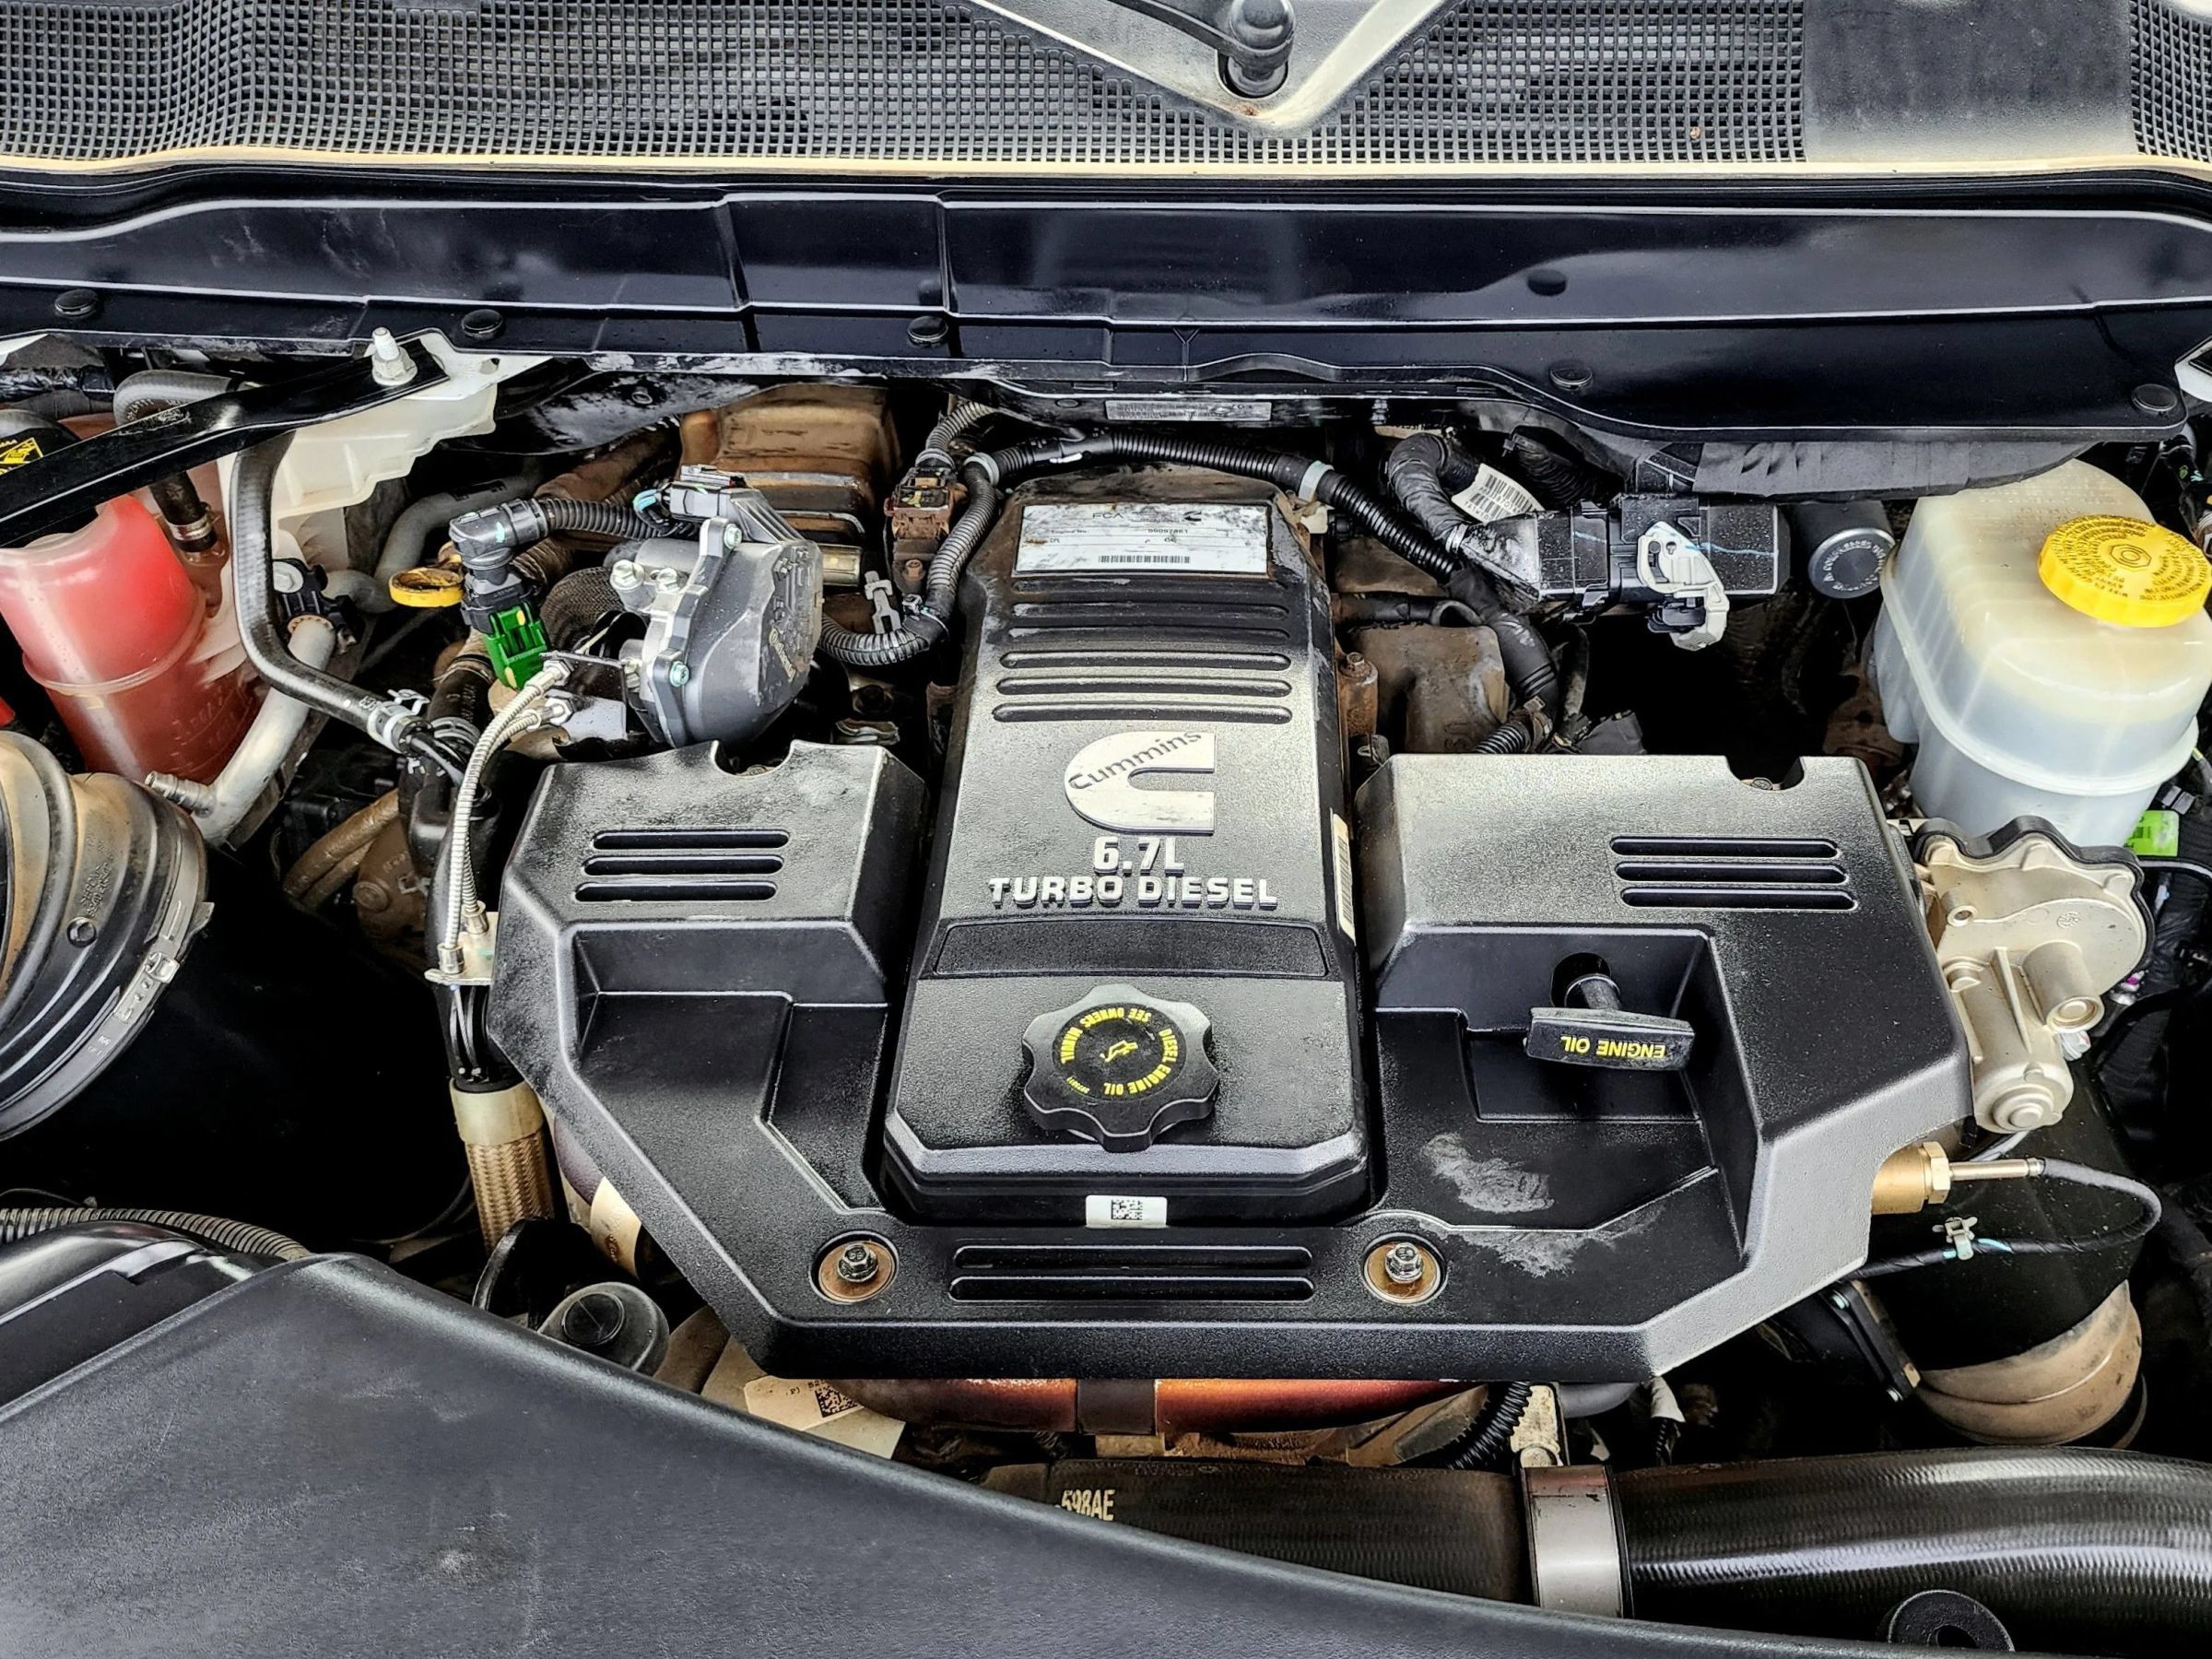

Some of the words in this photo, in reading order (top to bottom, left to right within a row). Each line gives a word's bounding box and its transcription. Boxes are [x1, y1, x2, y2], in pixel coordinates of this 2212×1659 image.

[1068, 731, 1202, 790] Cummins
[1093, 836, 1185, 876] 6.7L
[989, 877, 1124, 908] TURBO
[1137, 877, 1278, 910] DIESEL
[1079, 1006, 1125, 1028] OWNERS
[1127, 1007, 1152, 1023] SEE
[1061, 1026, 1083, 1065] MANUAL
[1159, 1028, 1179, 1062] DIESEL
[1560, 1035, 1592, 1053] OIL
[1595, 1039, 1666, 1059] ENGINE
[1103, 1082, 1124, 1095] OIL
[1126, 1064, 1171, 1094] ENGINE
